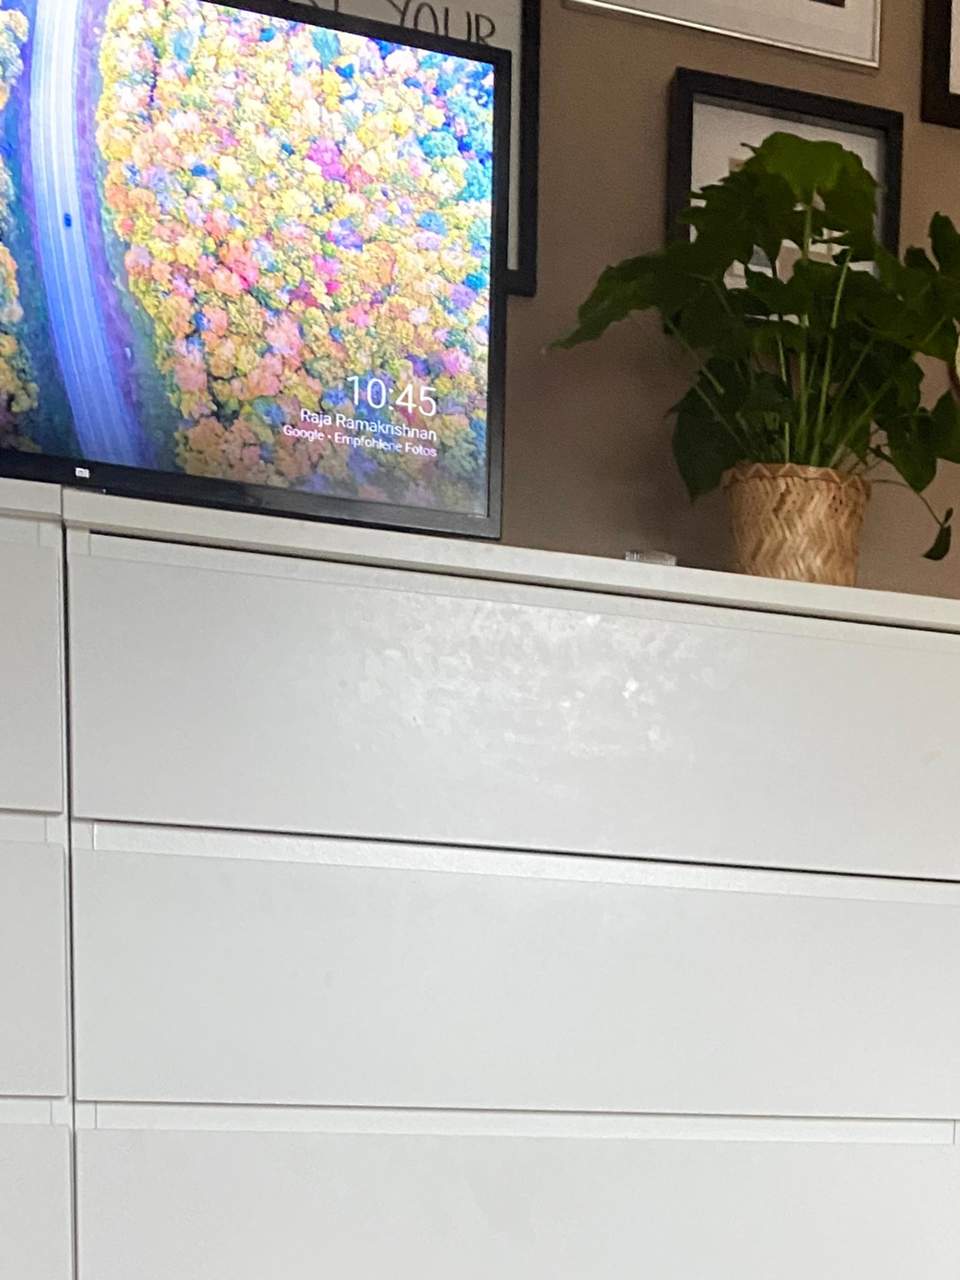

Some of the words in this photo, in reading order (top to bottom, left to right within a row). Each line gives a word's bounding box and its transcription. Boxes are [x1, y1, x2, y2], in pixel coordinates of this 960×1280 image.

[346, 375, 438, 417] 10:45
[283, 424, 325, 441] Google
[334, 432, 402, 452] Empfohlene
[404, 442, 438, 457] Fotos
[300, 407, 332, 427] Raja
[335, 413, 437, 442] Ramakrishnan
